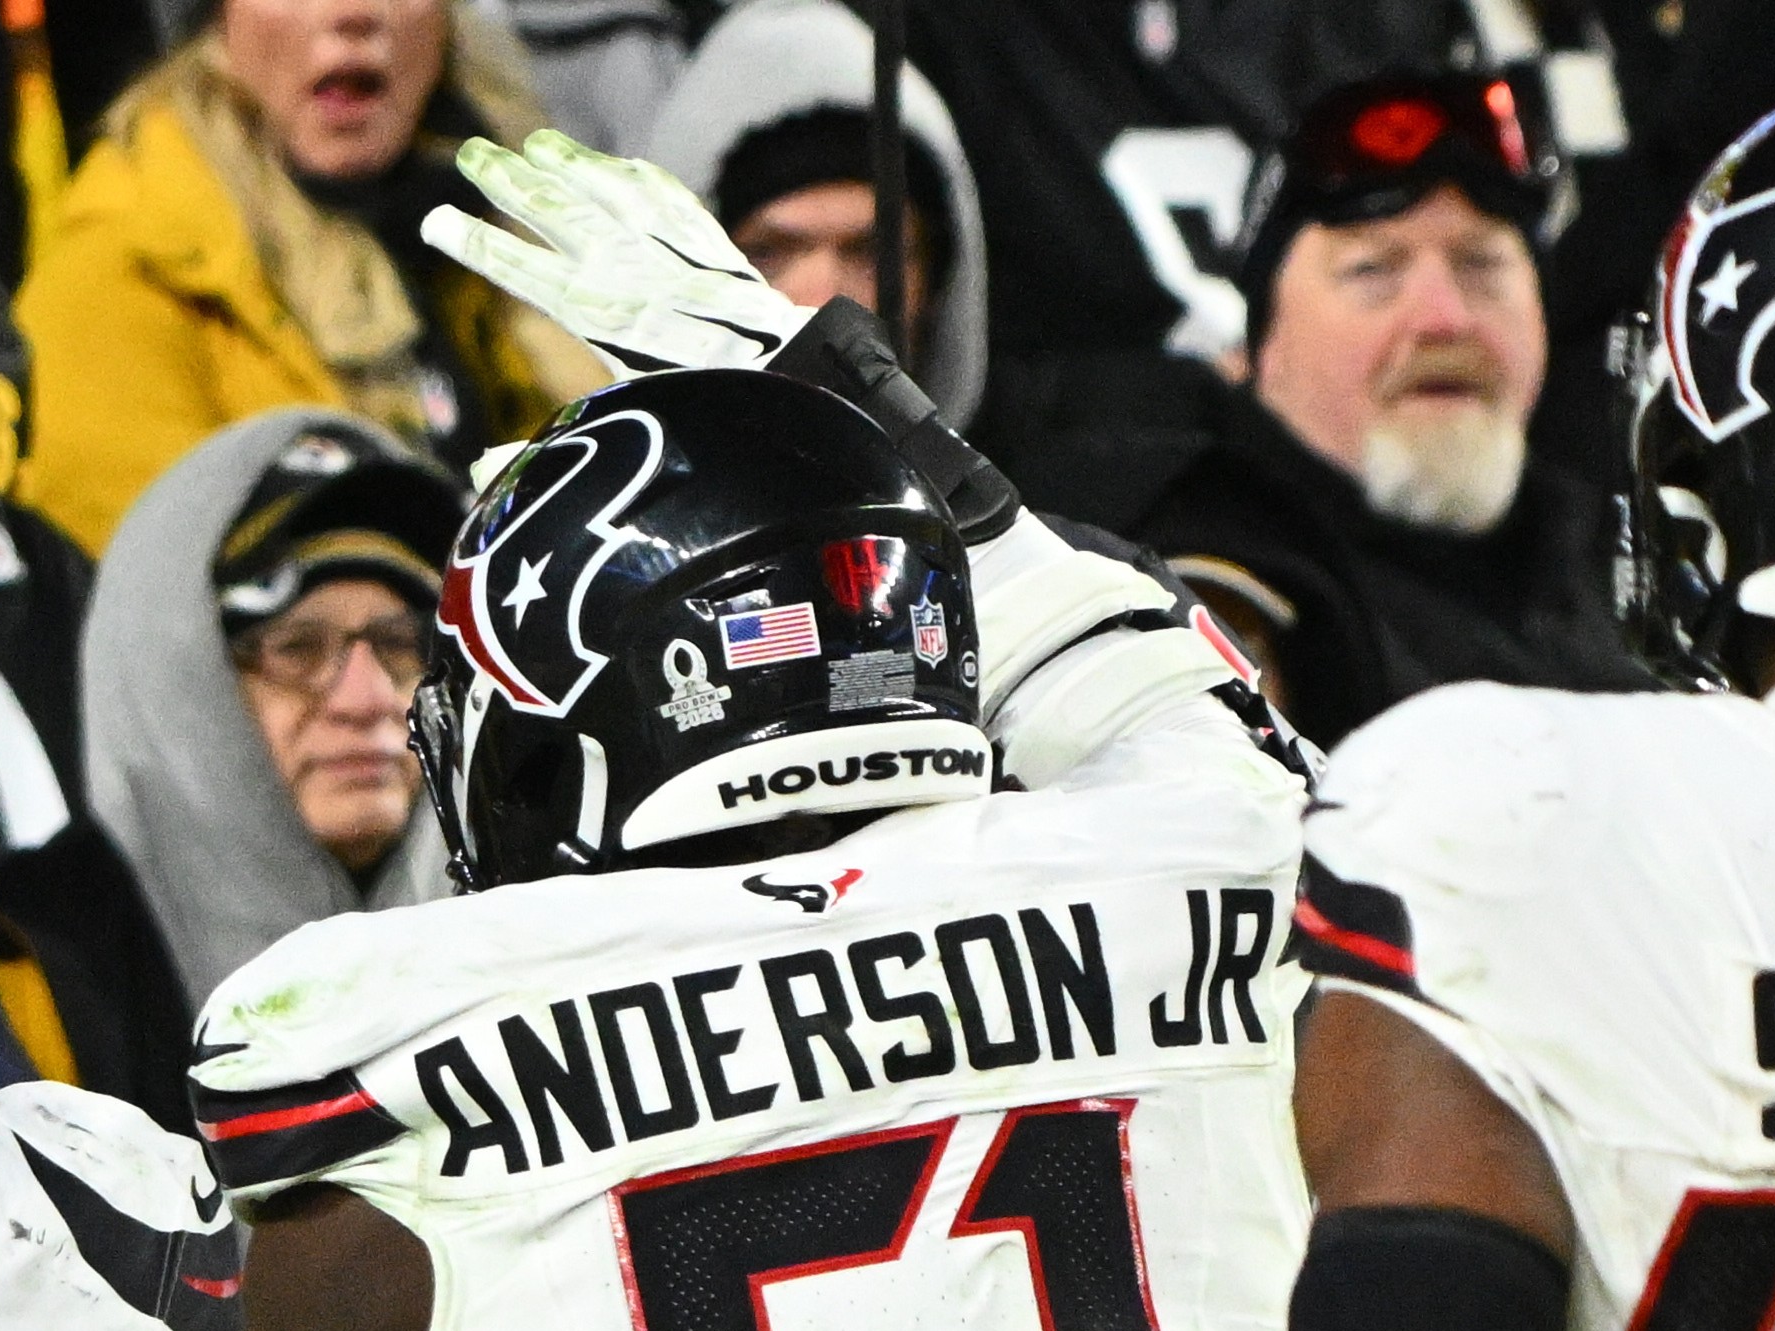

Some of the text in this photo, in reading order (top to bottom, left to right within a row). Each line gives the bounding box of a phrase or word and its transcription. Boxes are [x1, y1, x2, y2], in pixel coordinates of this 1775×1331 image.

[918, 627, 945, 654] NFL
[668, 691, 724, 715] PRO BOWL
[717, 747, 986, 810] HOUSTON
[412, 888, 1274, 1178] ANDERSON JR
